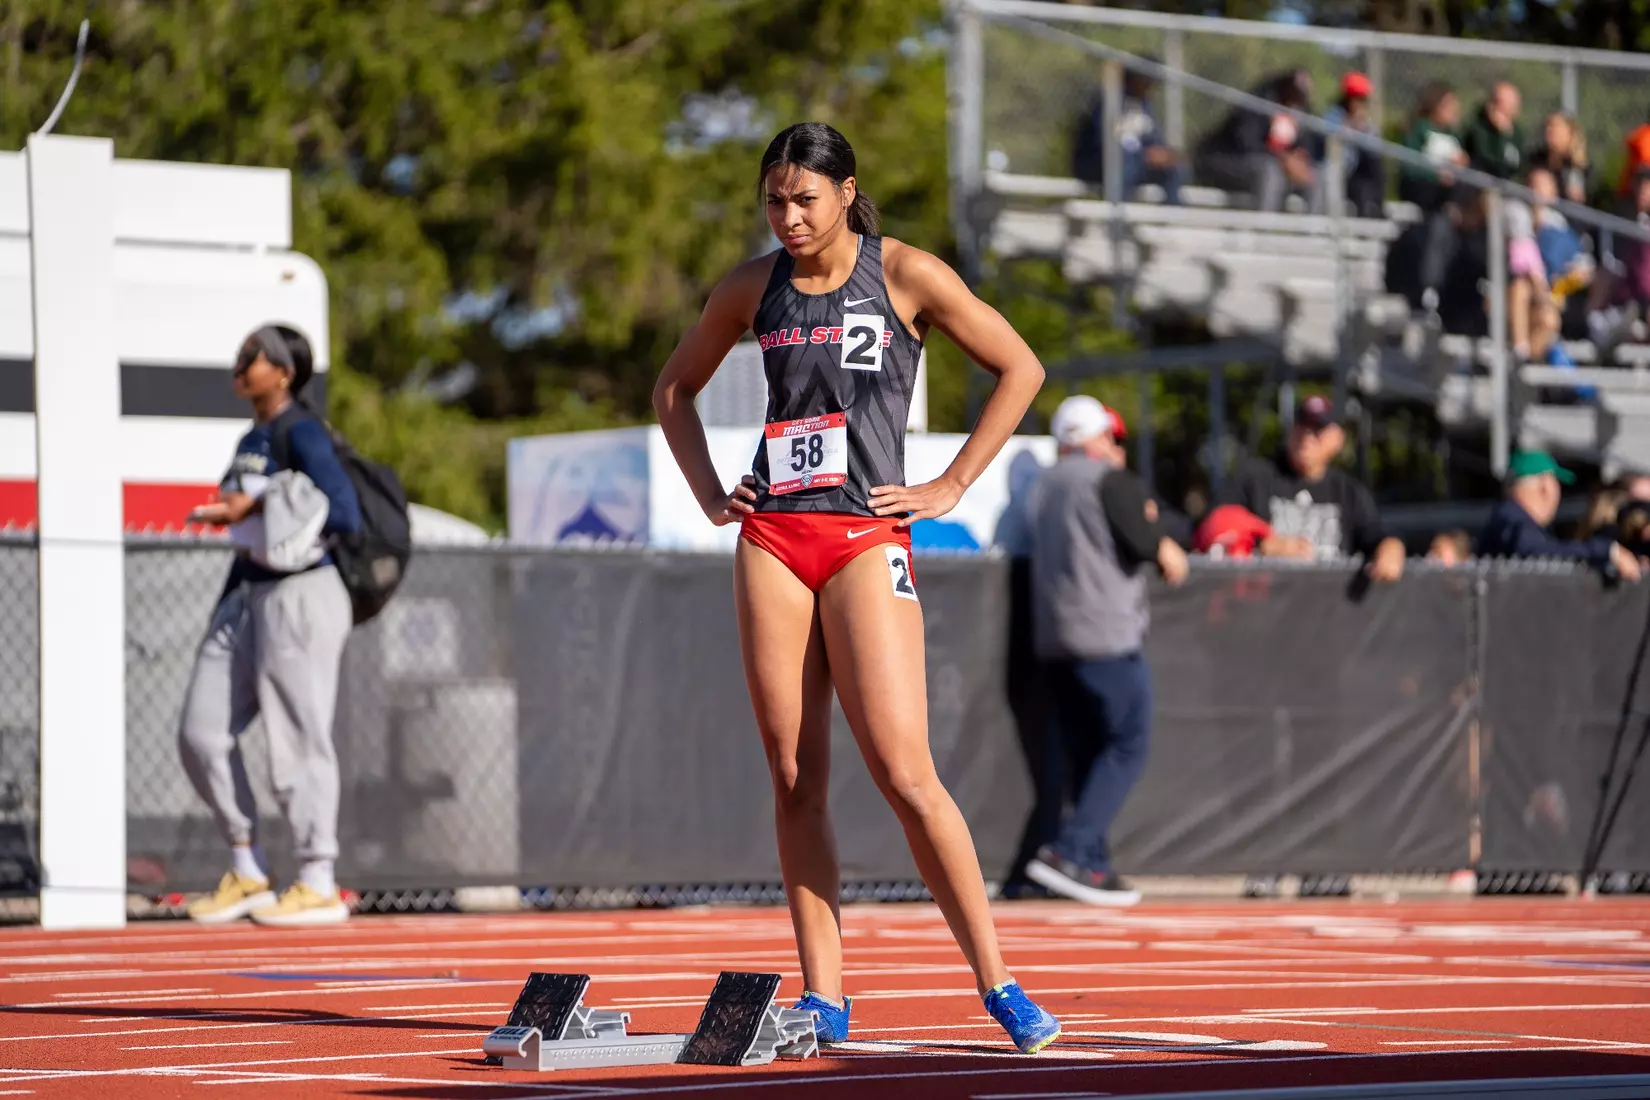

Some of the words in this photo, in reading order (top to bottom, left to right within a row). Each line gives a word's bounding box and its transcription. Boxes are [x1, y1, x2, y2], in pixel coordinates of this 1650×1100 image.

[760, 327, 806, 352] BALL
[845, 325, 877, 366] 2
[791, 433, 823, 472] 58
[891, 557, 914, 595] 2
